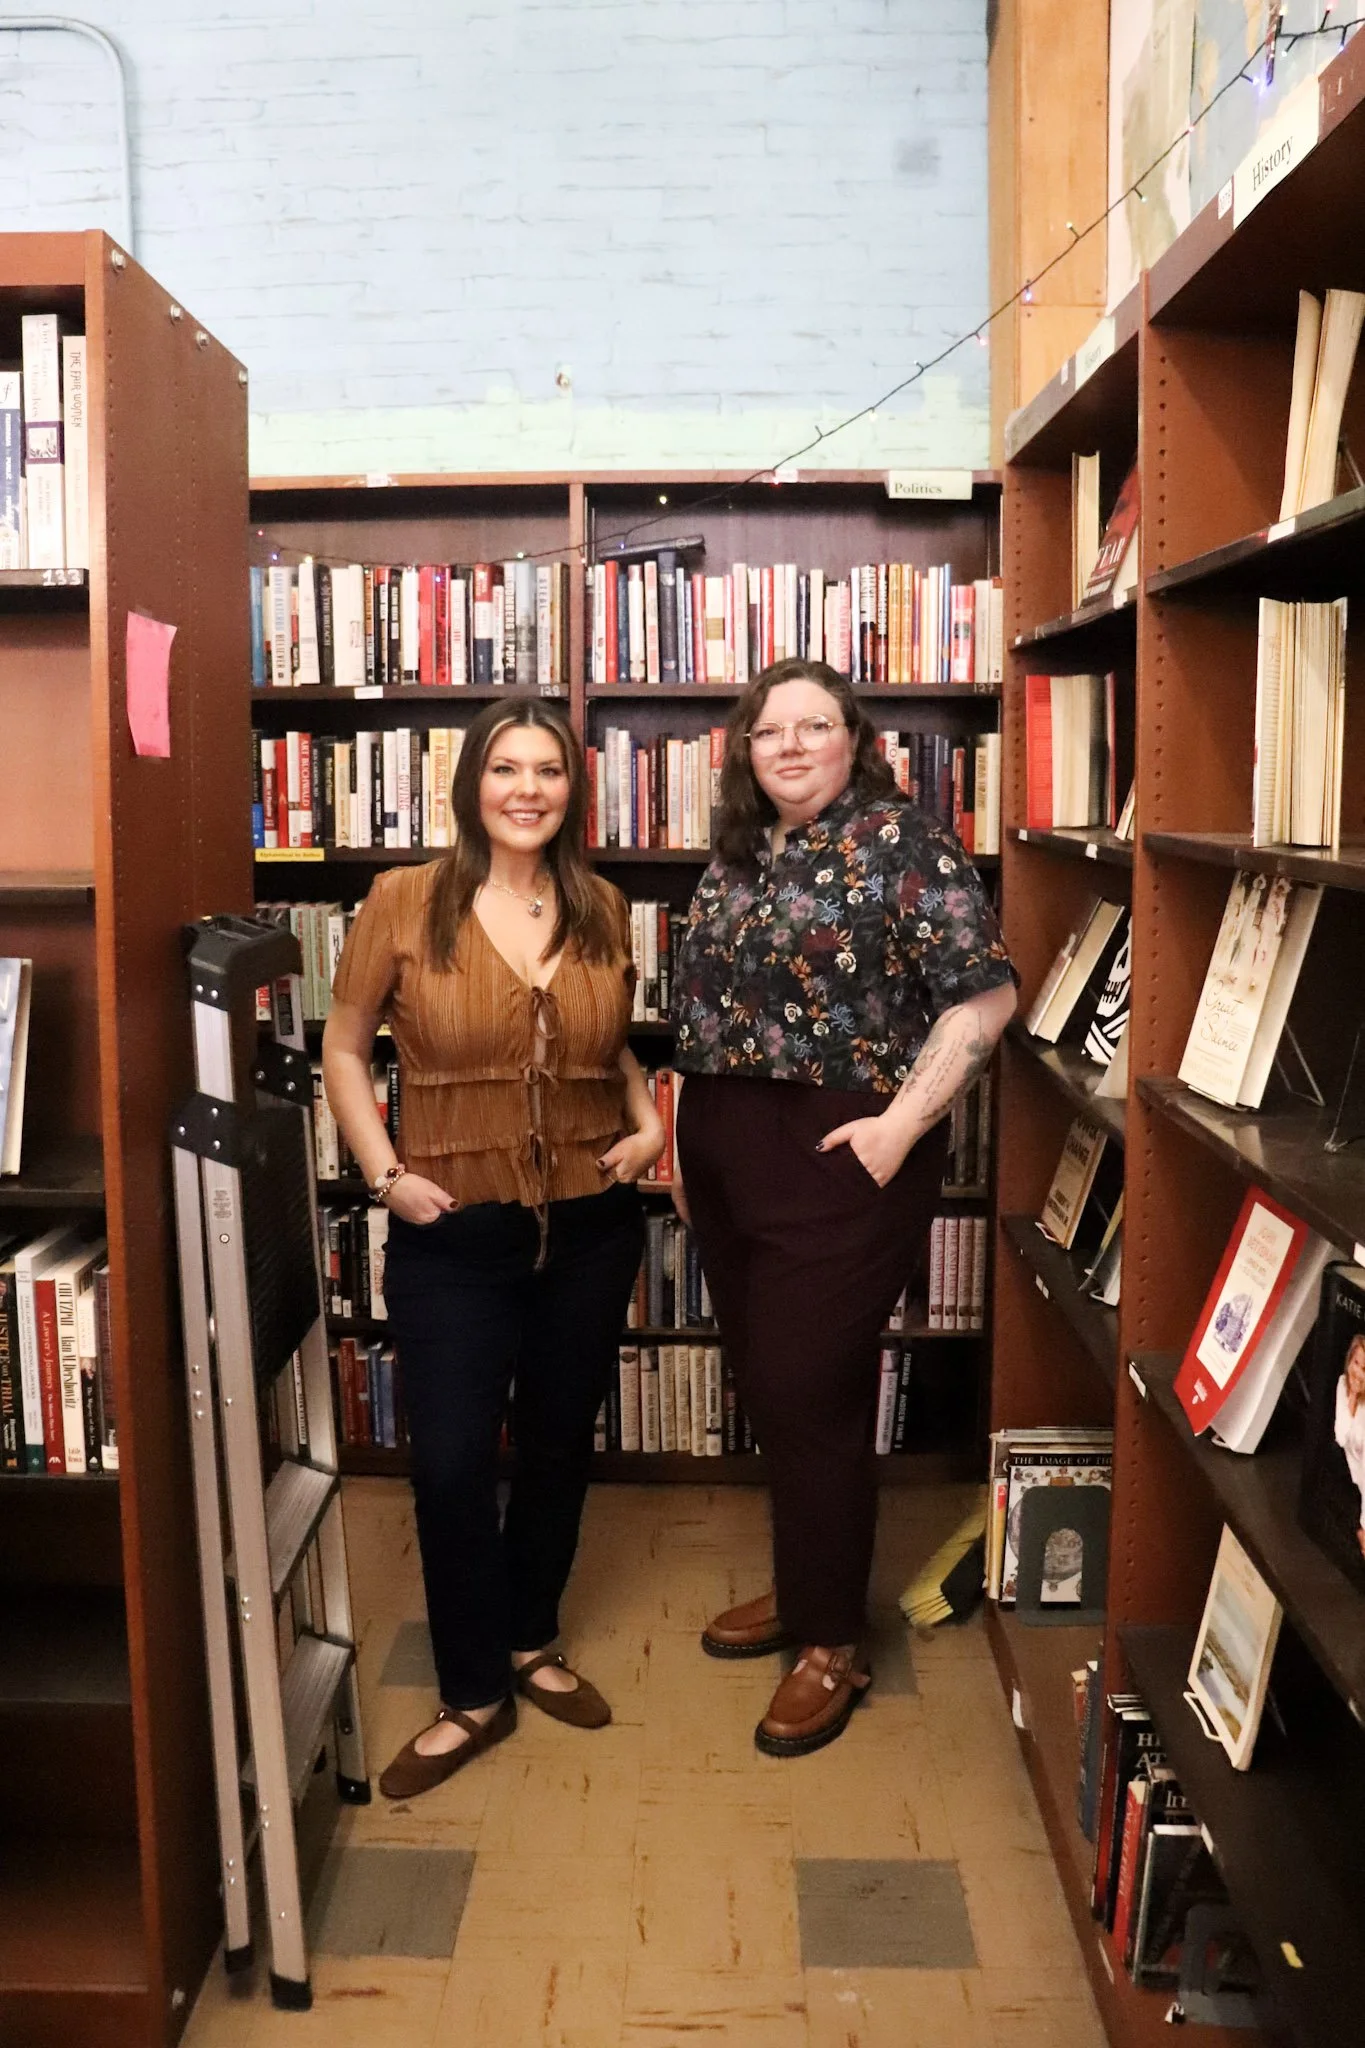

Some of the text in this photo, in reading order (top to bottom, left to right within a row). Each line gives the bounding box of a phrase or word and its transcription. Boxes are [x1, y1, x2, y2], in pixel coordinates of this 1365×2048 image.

[1252, 135, 1294, 192] History
[70, 351, 82, 429] THE FAIR WOMEN
[894, 481, 943, 495] Politics
[42, 569, 81, 586] 133
[300, 739, 311, 807] ART BUCHWALD
[399, 774, 410, 811] GIVING
[58, 1282, 75, 1327] CHUTZPAH
[1335, 1292, 1362, 1320] KATIE
[41, 1310, 55, 1390] A Lawyer's Journey
[61, 1336, 76, 1353] Alan
[1, 1377, 14, 1418] TRIAL
[63, 1363, 80, 1409] Dershowitz
[895, 1352, 912, 1441] FORWARD ANDREW YANG
[1013, 1456, 1035, 1465] THE
[1038, 1455, 1068, 1465] IMAGE
[1075, 1456, 1090, 1465] OF
